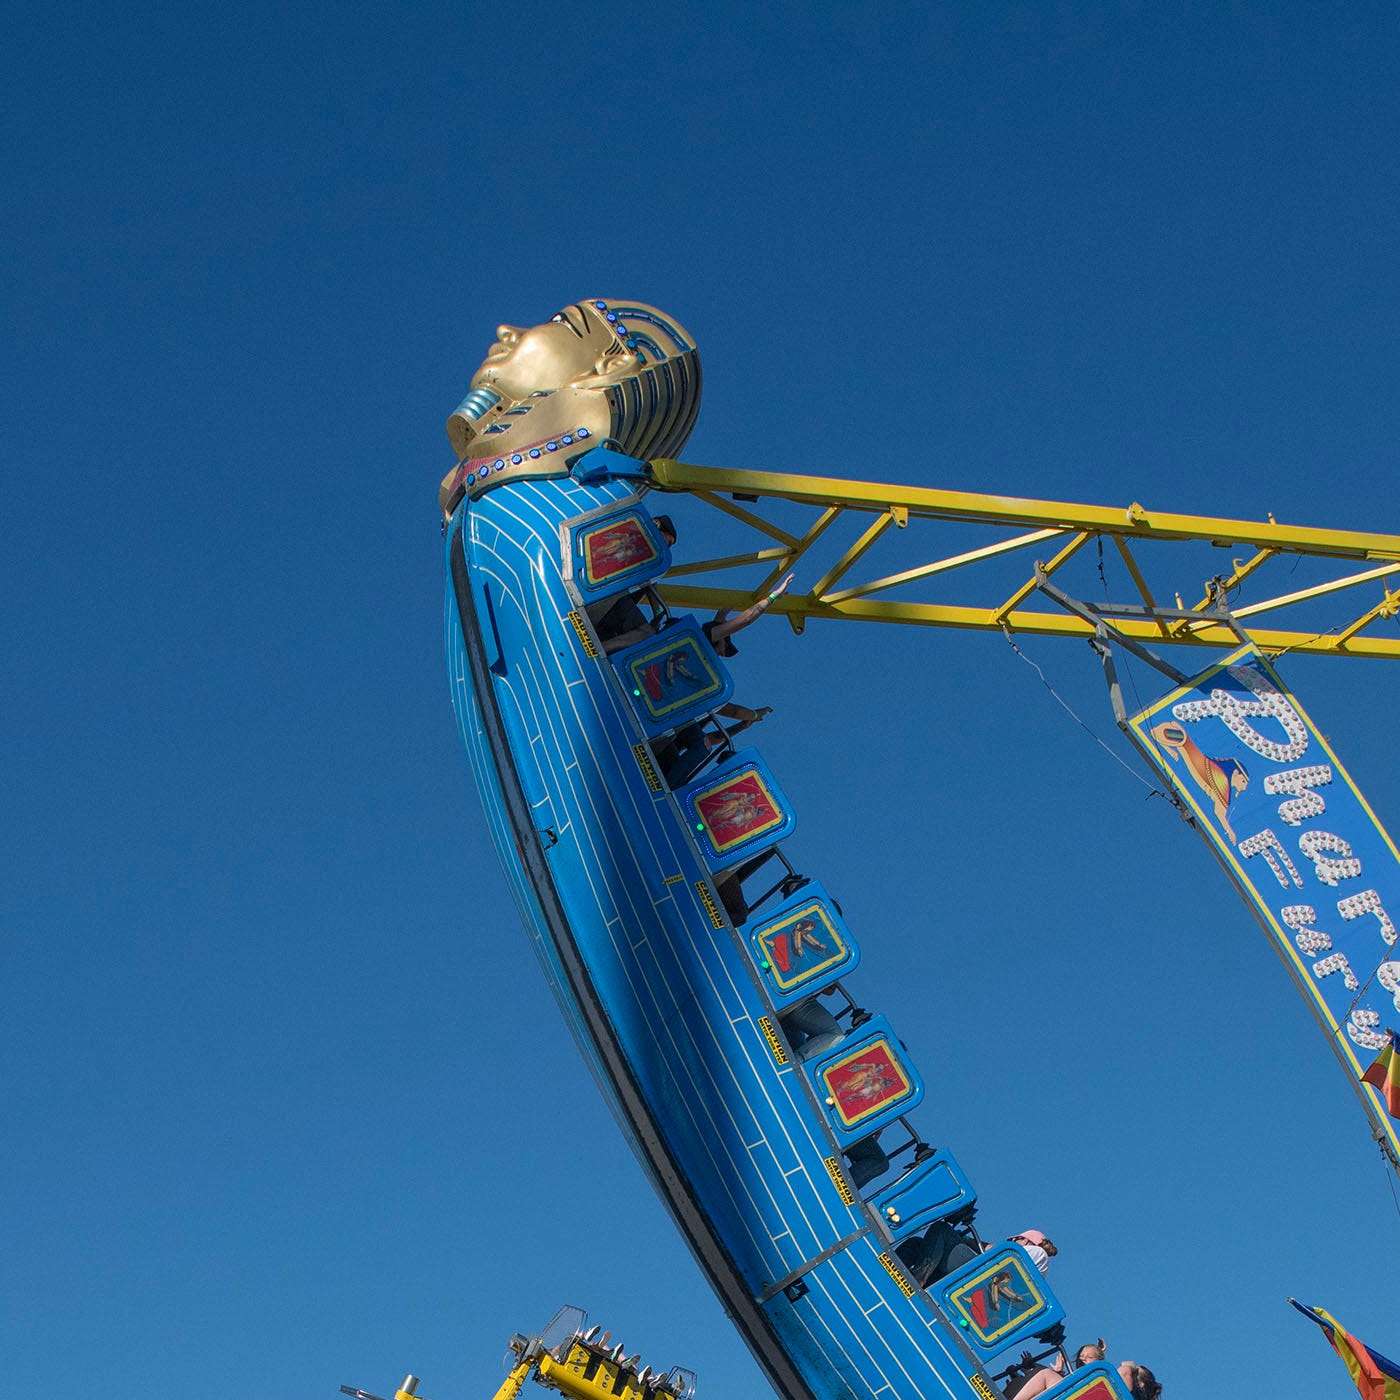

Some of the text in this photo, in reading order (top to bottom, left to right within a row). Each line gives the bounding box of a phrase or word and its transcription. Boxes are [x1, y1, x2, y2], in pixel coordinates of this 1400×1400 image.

[573, 612, 598, 657] CAUTION
[638, 744, 662, 790] CAUTION
[700, 882, 724, 927] CAUTION
[763, 1017, 788, 1063] CAUTION
[830, 1158, 855, 1204] CAUTION
[883, 1254, 915, 1295] CAUTION
